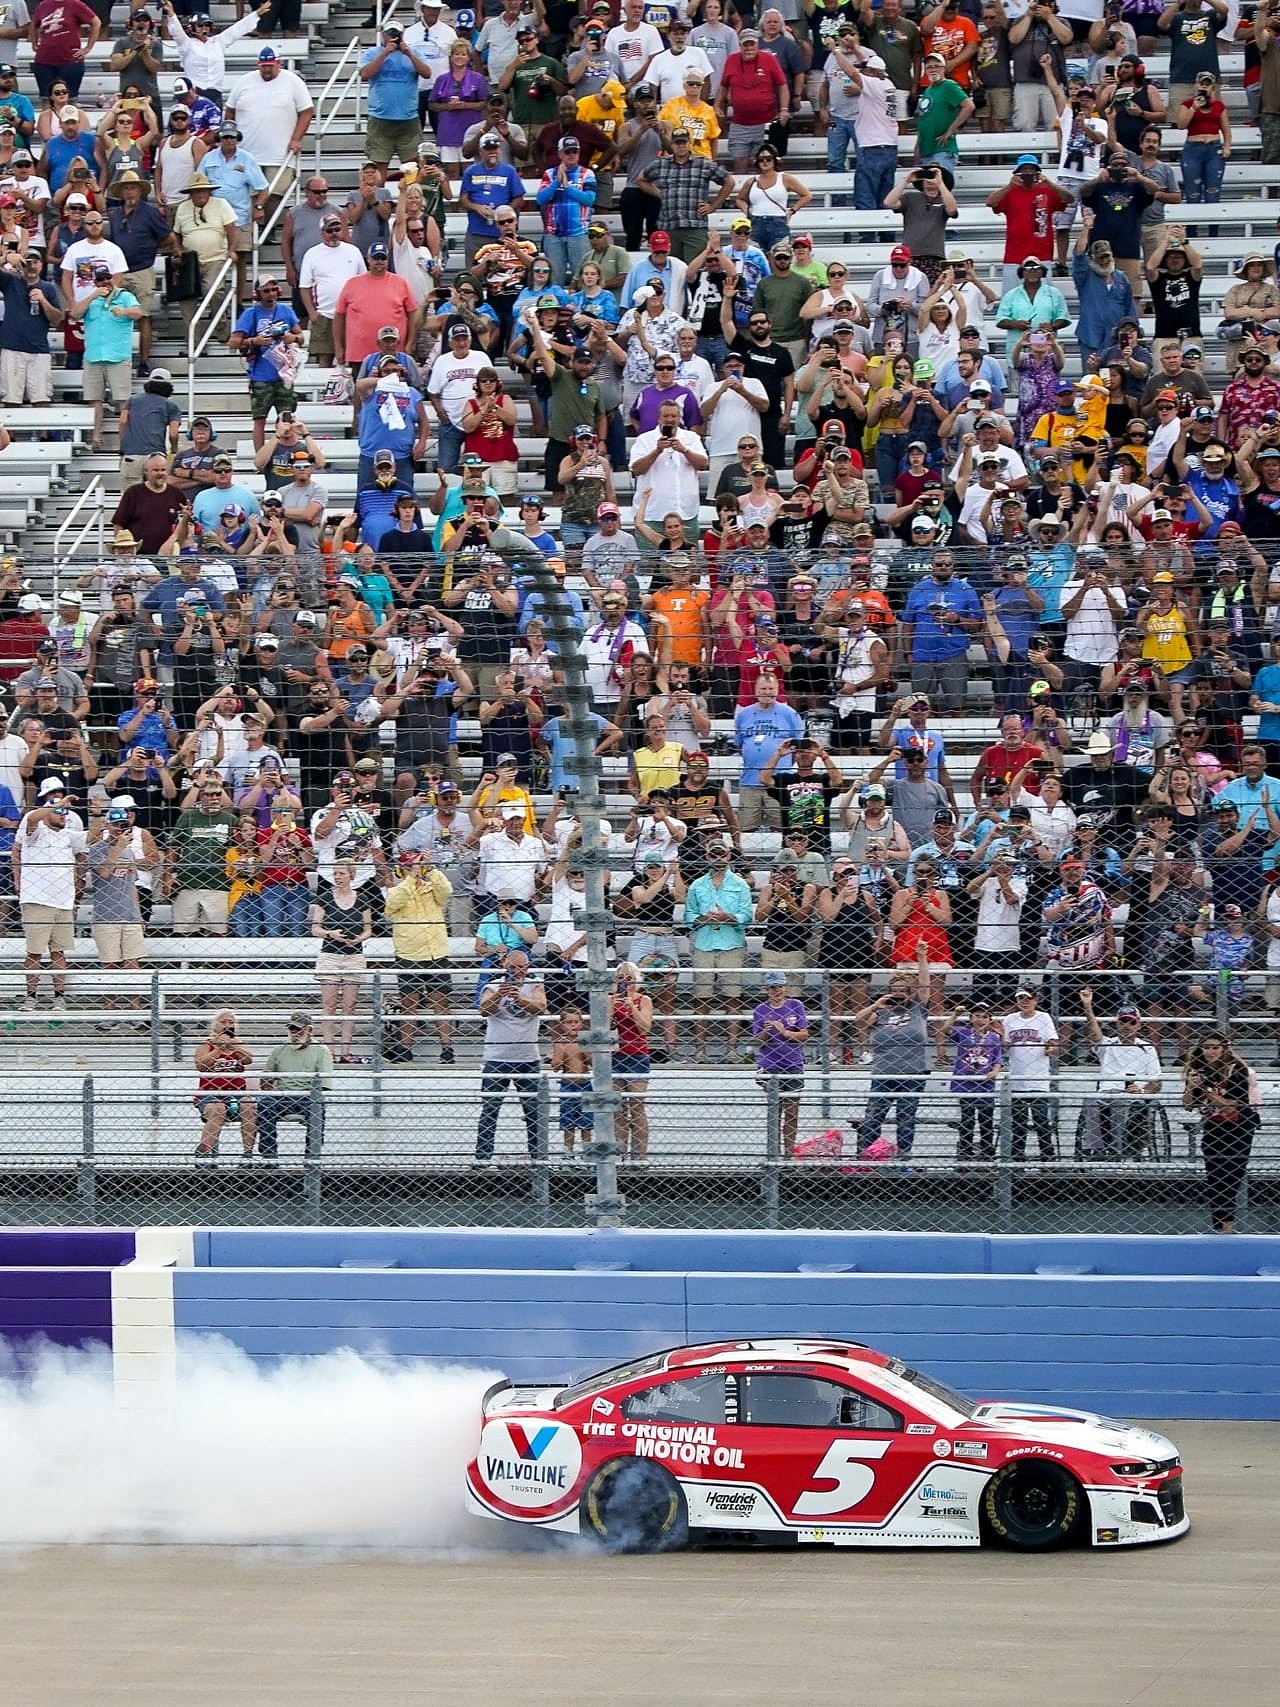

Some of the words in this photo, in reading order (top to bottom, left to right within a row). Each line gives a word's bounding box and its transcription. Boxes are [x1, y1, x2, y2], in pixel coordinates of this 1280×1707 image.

[582, 1423, 617, 1436] THE
[621, 1424, 717, 1446] ORIGINAL
[635, 1437, 710, 1465] MOTOR
[713, 1448, 745, 1468] OIL
[1005, 1445, 1065, 1459] GOODYEAR
[486, 1455, 568, 1489] VALVOLINE
[791, 1438, 893, 1516] 5
[511, 1485, 544, 1494] TRUSTED
[705, 1491, 757, 1507] Hendrick
[715, 1503, 754, 1512] cars.com
